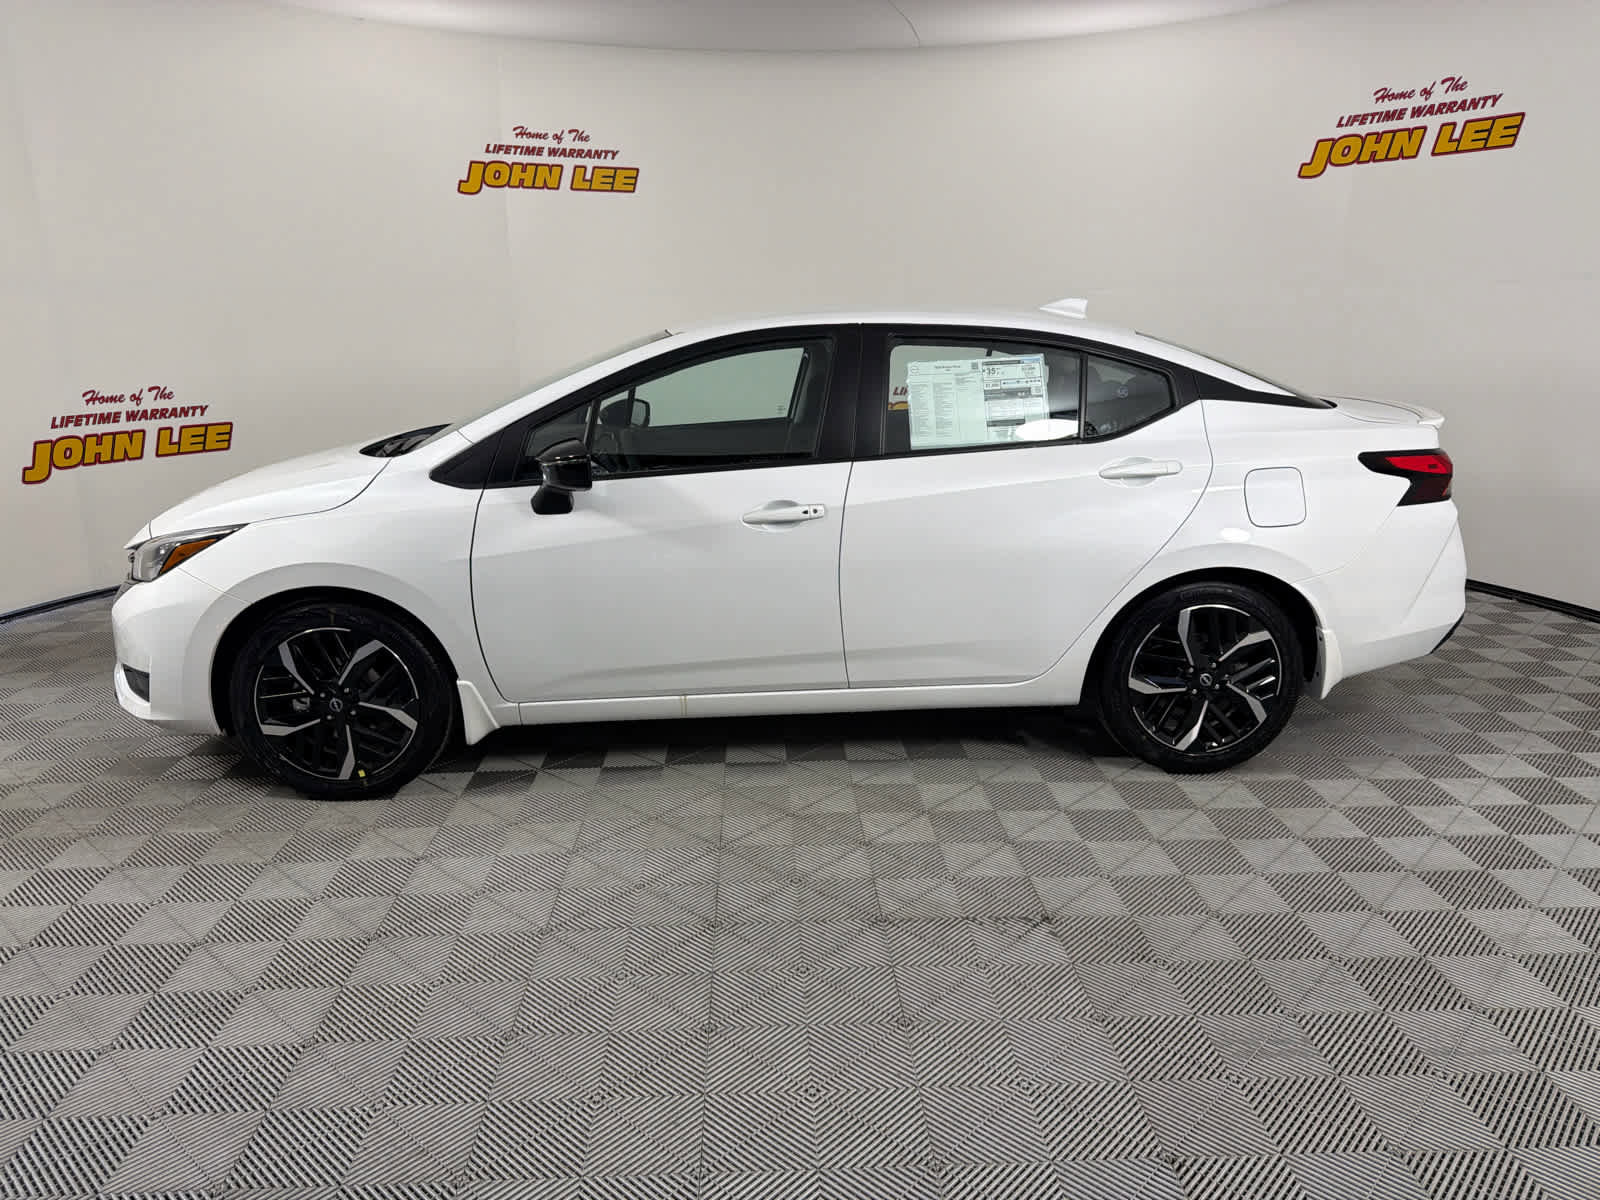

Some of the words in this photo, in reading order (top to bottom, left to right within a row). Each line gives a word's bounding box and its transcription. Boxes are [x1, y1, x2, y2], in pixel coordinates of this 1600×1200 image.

[1373, 87, 1415, 104] Home
[1419, 81, 1436, 101] of
[1440, 75, 1468, 94] The
[1336, 108, 1408, 128] LIFETIME
[1410, 93, 1504, 119] WARRANTY
[512, 125, 550, 140] Home
[552, 130, 565, 144] of
[568, 128, 590, 143] The
[1297, 126, 1427, 179] JOHN
[1431, 112, 1525, 156] LEE
[484, 143, 545, 157] LIFETIME
[547, 146, 620, 160] WARRANTY
[457, 160, 563, 195] JOHN
[570, 165, 639, 193] LEE
[82, 389, 126, 406] Home
[129, 388, 144, 406] of
[148, 385, 175, 401] The
[50, 411, 122, 429] LIFETIME
[125, 405, 208, 422] WARRANTY
[21, 429, 146, 484] JOHN
[155, 421, 233, 458] LEE
